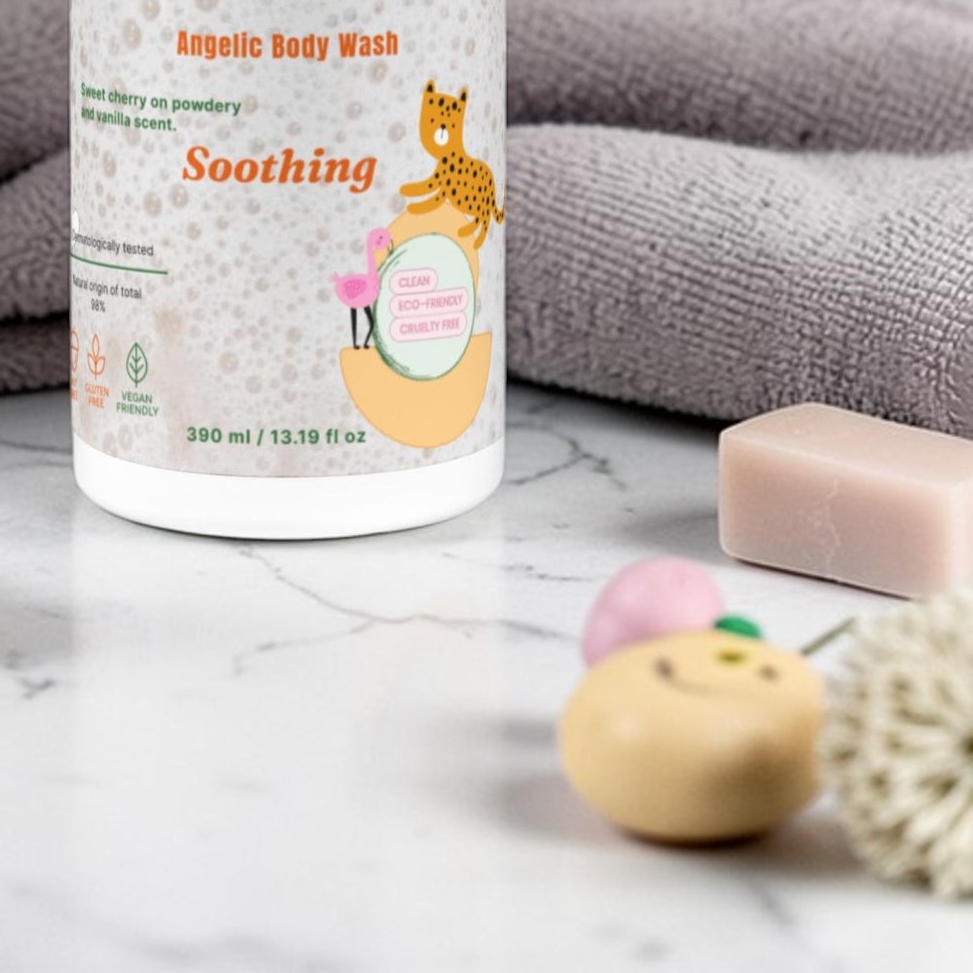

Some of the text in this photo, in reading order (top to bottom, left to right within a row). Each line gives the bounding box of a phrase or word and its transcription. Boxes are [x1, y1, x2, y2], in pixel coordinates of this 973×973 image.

[176, 30, 398, 61] Angelic Body Wash
[81, 82, 242, 116] Sweet cherry on powdery
[81, 106, 177, 131] and vanilla scent.
[182, 145, 378, 193] Soothing
[123, 242, 154, 256] tested
[89, 281, 109, 296] origin
[110, 283, 119, 296] of
[121, 287, 142, 299] total
[398, 276, 430, 288] CLEAN
[91, 298, 106, 312] 98%
[398, 294, 464, 312] ECO-FRIENDLY
[399, 318, 460, 335] CRUELTY FREE
[85, 383, 109, 397] GLUTEN
[121, 391, 153, 404] VEGAN
[89, 396, 104, 408] FREE
[116, 402, 159, 417] FRIENDLY
[187, 426, 366, 446] 390 ml / 13.19 fl oz
